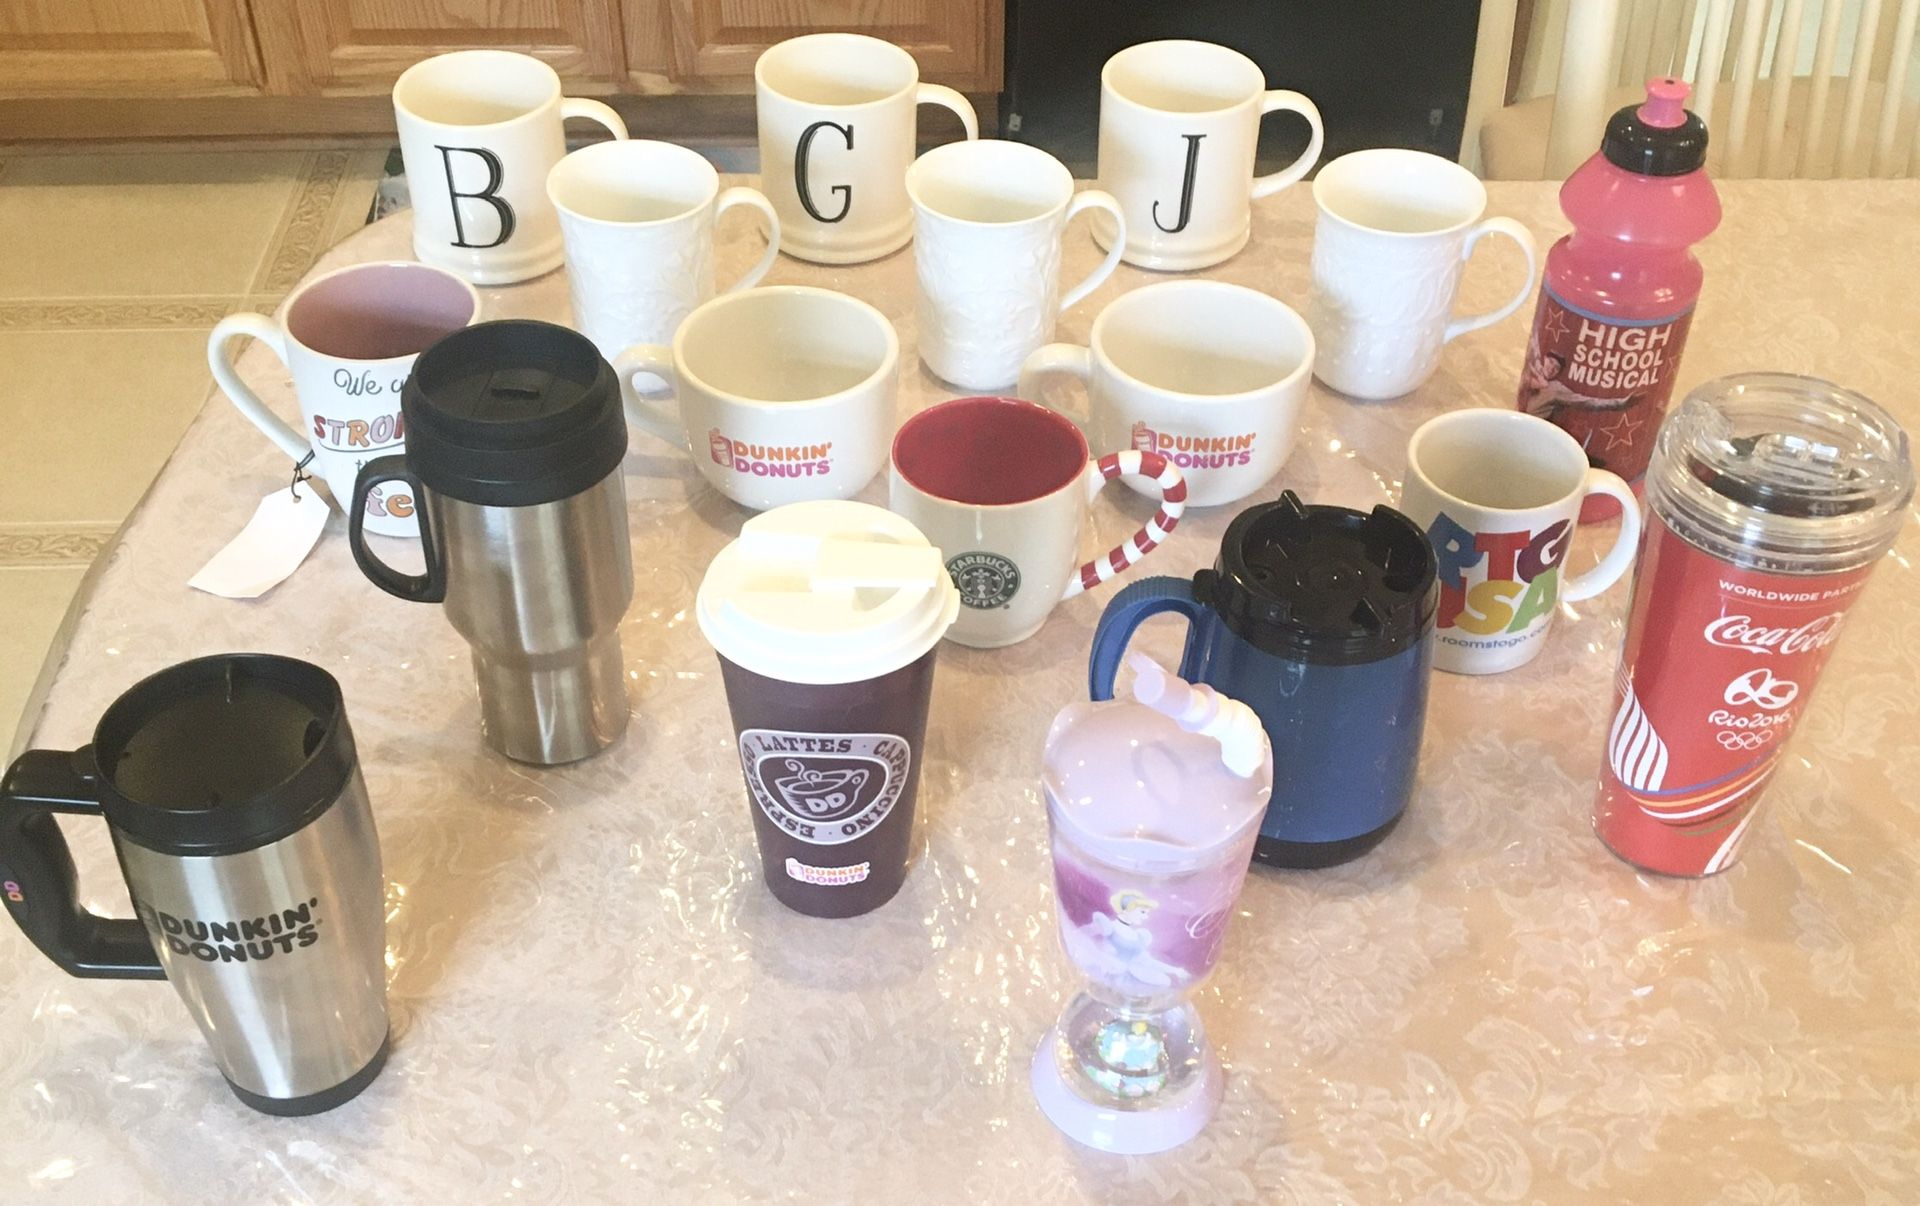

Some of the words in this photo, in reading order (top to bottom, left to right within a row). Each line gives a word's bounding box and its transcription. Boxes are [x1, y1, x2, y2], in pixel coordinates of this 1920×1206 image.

[794, 121, 854, 224] G
[1152, 134, 1207, 234] J
[434, 145, 517, 249] B
[1578, 319, 1672, 350] HIGH
[1573, 344, 1664, 371] SCHOOL
[334, 368, 383, 396] We
[1568, 362, 1659, 389] MUSICAL
[733, 440, 832, 461] DUNKIN'
[1158, 432, 1256, 452] DUNKIN'
[735, 457, 830, 477] DONUTS
[950, 555, 1016, 579] STARBUCKS
[960, 591, 1007, 607] OFFEE
[1719, 579, 1820, 602] WORLDWIDE
[755, 735, 853, 753] LATTES
[805, 792, 847, 812] DD
[805, 873, 865, 883] DONUTS
[159, 897, 318, 943] DUNKIN'
[166, 924, 319, 963] DONUTS
